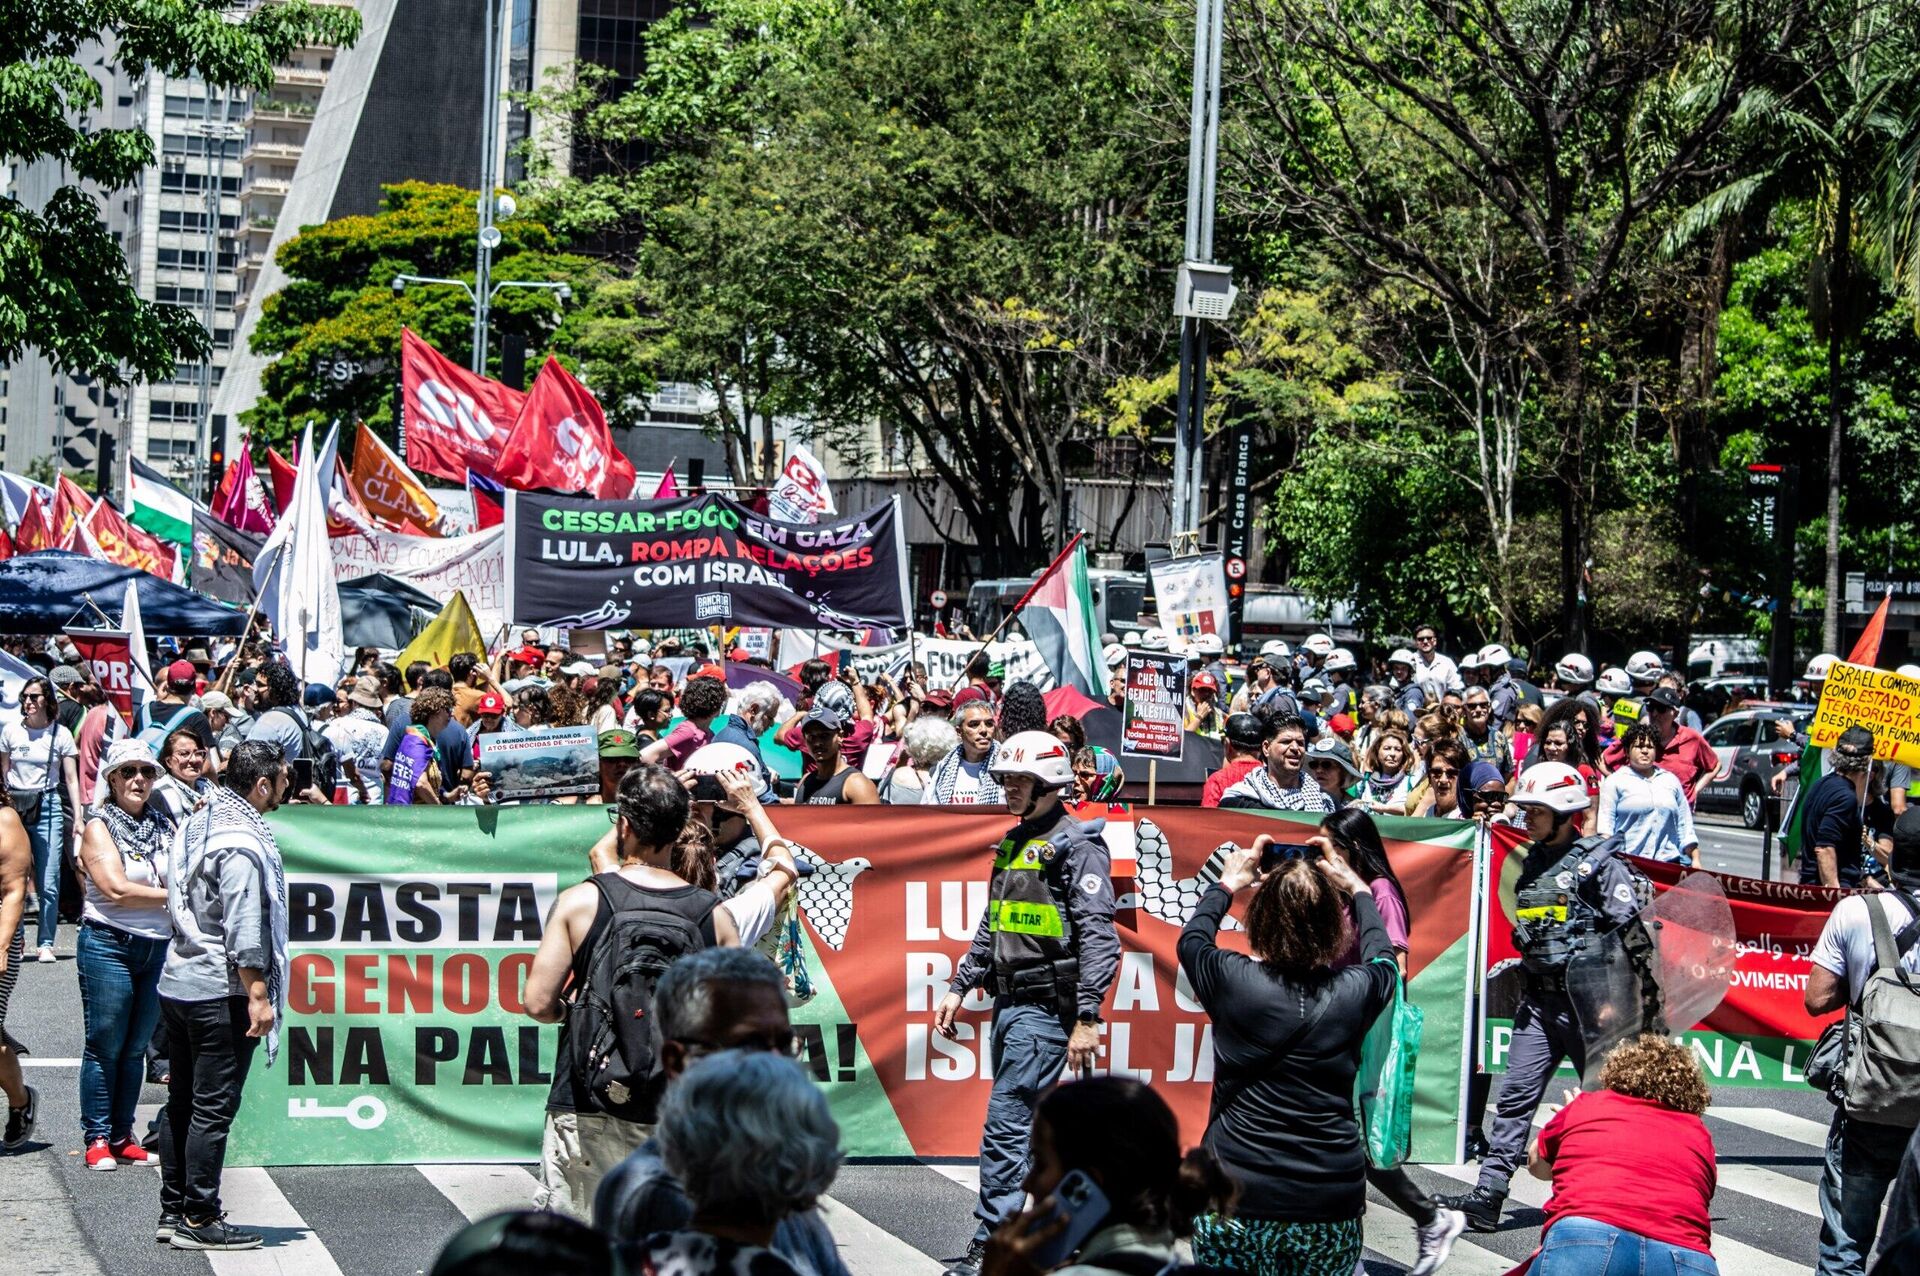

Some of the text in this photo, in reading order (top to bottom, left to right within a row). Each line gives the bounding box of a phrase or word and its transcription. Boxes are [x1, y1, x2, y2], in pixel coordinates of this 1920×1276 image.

[1231, 434, 1249, 557] Al. Casa Branca
[542, 503, 873, 549] CESSAR-FOGO EM GAZA
[542, 535, 875, 578] LULA, ROMPA RELAÇÕES
[633, 561, 794, 593] COM ISRAEL
[1137, 671, 1176, 688] CHEGA DE
[1829, 663, 1920, 698] ISRAEL COMPOR
[1128, 687, 1182, 706] GENOCÍDIO NA
[1824, 684, 1911, 711] COMO ESTADO
[1133, 702, 1176, 721] PALESTINA
[1824, 698, 1913, 729] TERRORISTA
[1127, 730, 1145, 740] todas
[1149, 724, 1168, 734] rompa
[1815, 728, 1839, 742] EM
[509, 741, 552, 750] GENOCIDAS
[1714, 786, 1739, 796] MILITAR
[1717, 872, 1816, 900] ALESTINA
[288, 882, 542, 943] BASTA
[1009, 911, 1042, 926] MILITAR
[1729, 970, 1810, 990] OVIMENT
[288, 1026, 391, 1086] NA
